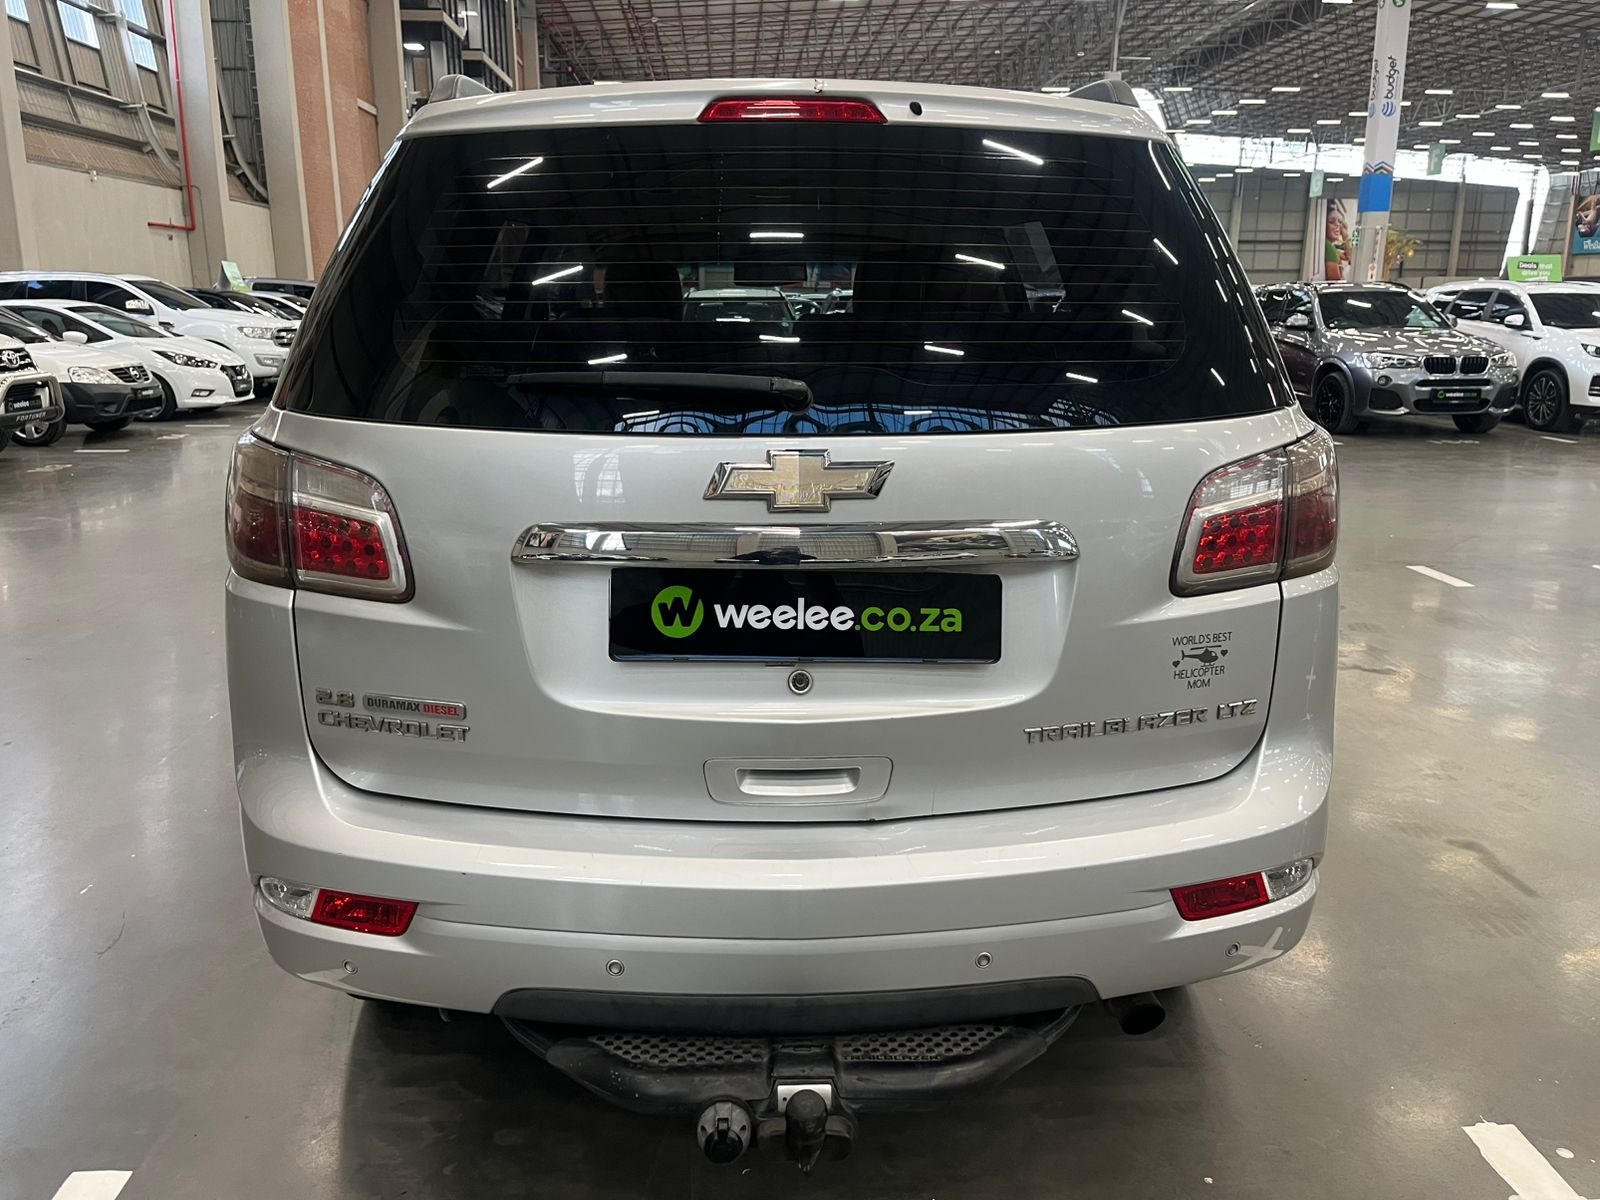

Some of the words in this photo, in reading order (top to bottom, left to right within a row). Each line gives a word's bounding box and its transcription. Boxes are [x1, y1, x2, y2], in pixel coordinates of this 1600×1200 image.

[1384, 55, 1399, 99] budget
[16, 411, 47, 422] FORTUNER
[713, 597, 963, 633] weelee.co.za
[1172, 634, 1212, 647] WORLD'S
[1213, 631, 1233, 643] BEST
[1173, 665, 1226, 680] HELICOPTER
[1187, 678, 1211, 690] MOM
[315, 687, 355, 708] 2.8
[367, 696, 420, 712] DURAMAX
[423, 703, 460, 717] DIESEL
[318, 710, 471, 743] CHEVROLET
[1023, 707, 1209, 745] TRAILBLAZER
[1216, 698, 1258, 720] LTZ
